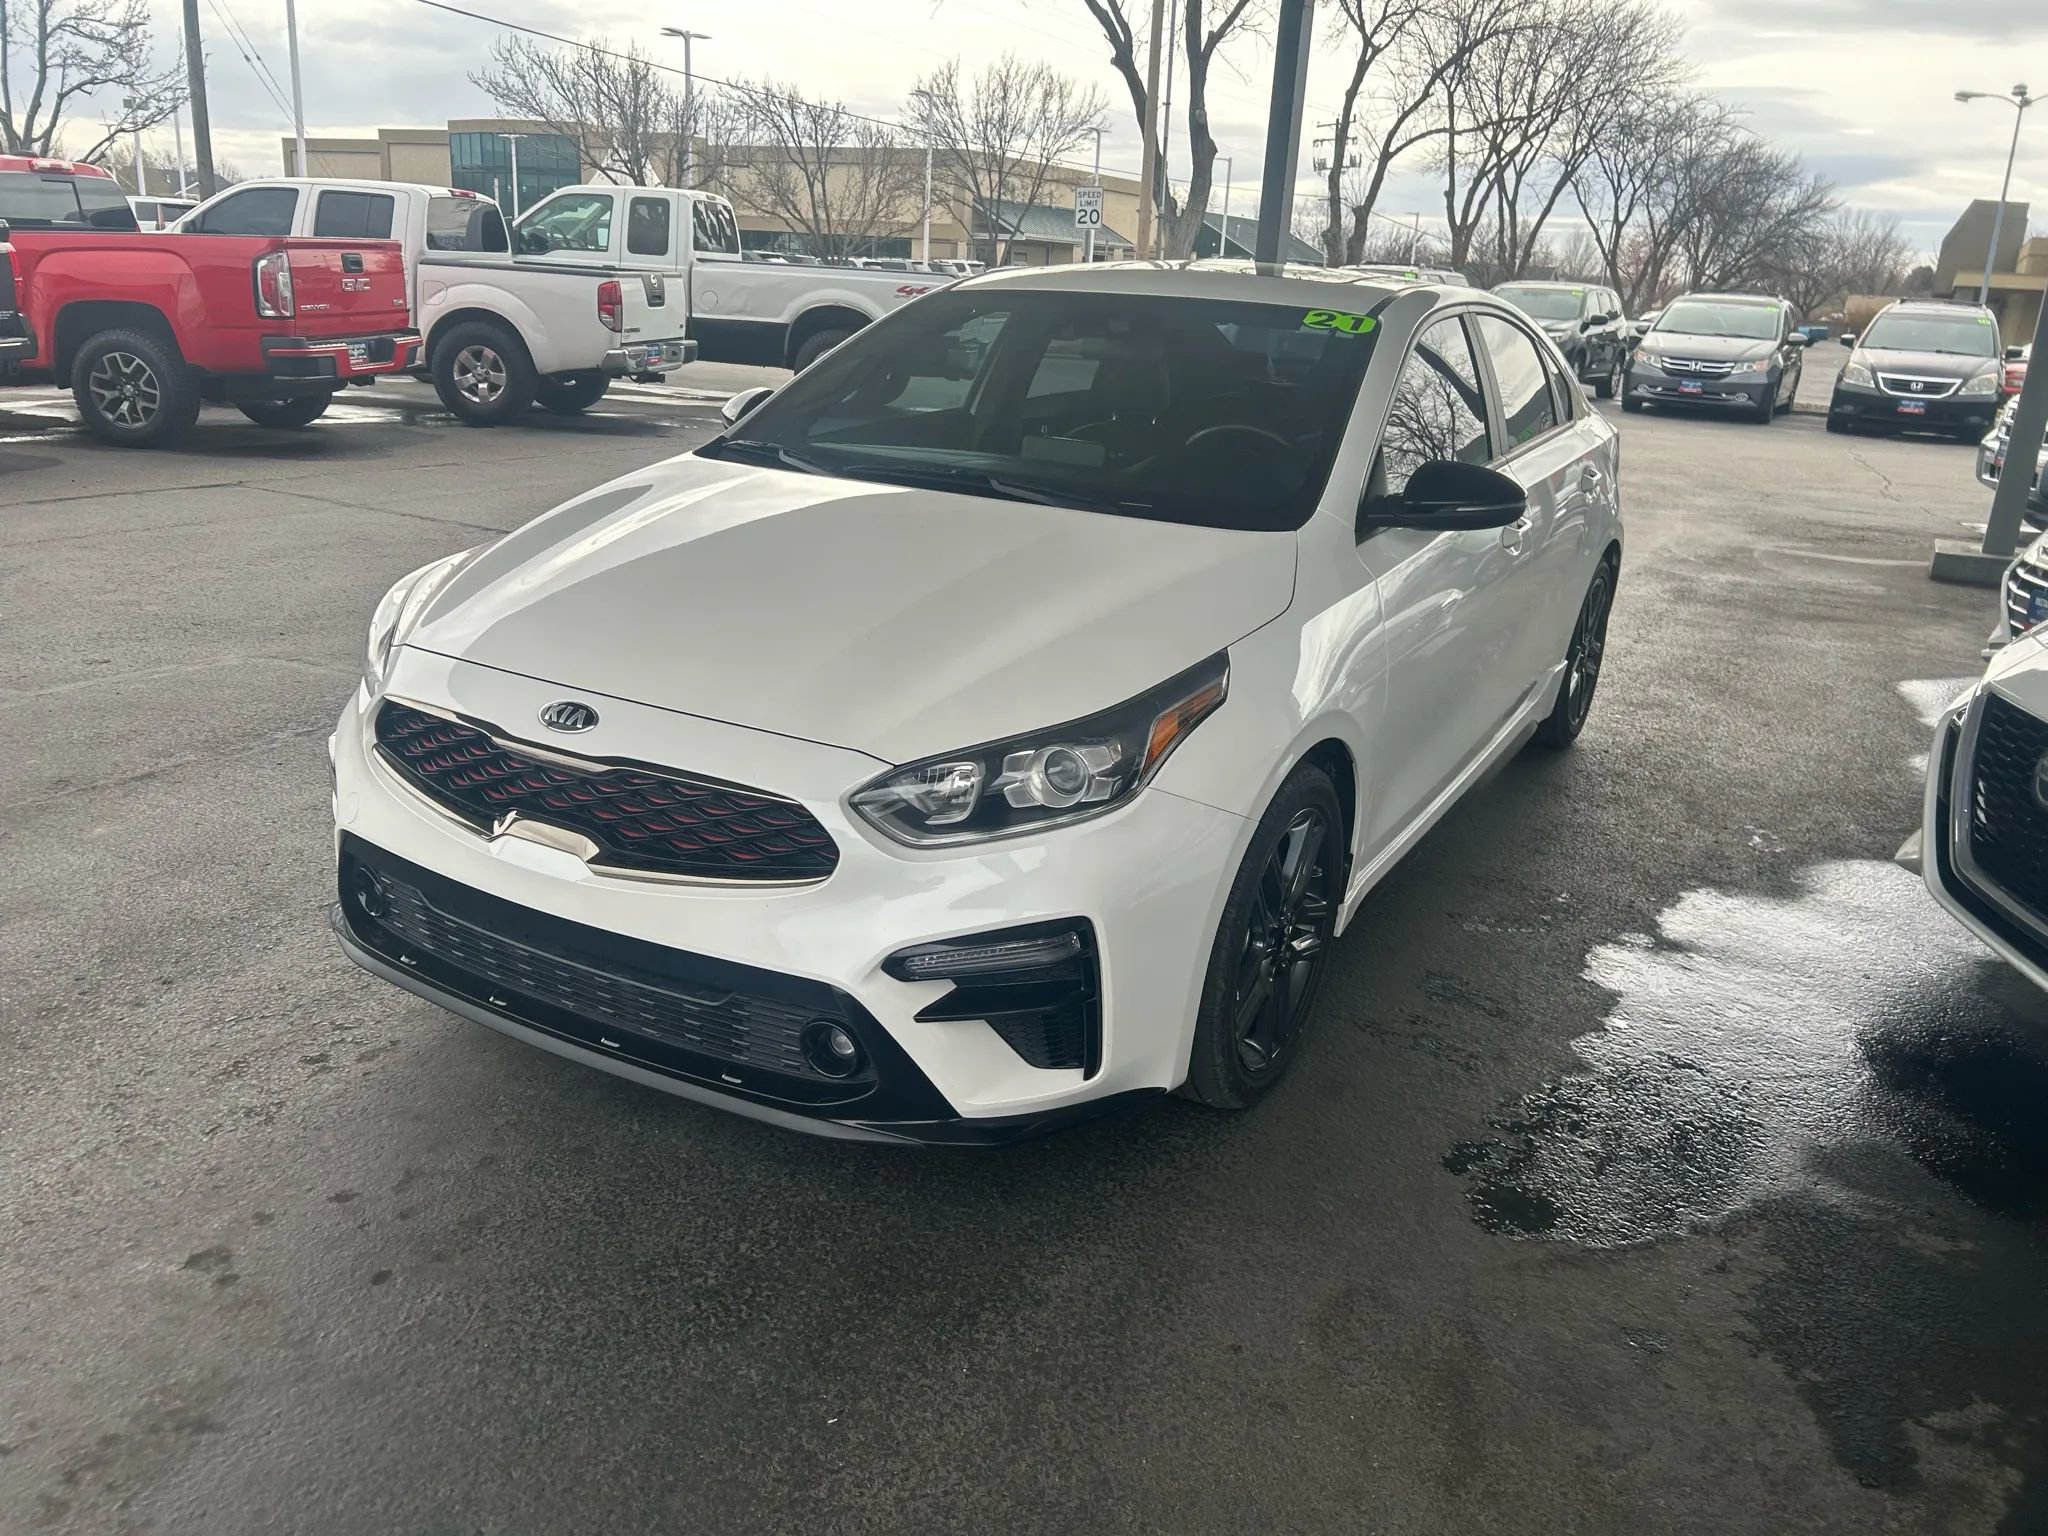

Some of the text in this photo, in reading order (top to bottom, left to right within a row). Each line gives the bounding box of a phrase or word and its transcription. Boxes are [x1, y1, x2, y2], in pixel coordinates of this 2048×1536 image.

[1077, 191, 1101, 199] SPEED
[1077, 209, 1100, 225] 20
[341, 278, 371, 292] GMC
[1306, 312, 1368, 331] 21
[544, 703, 587, 728] KIA
